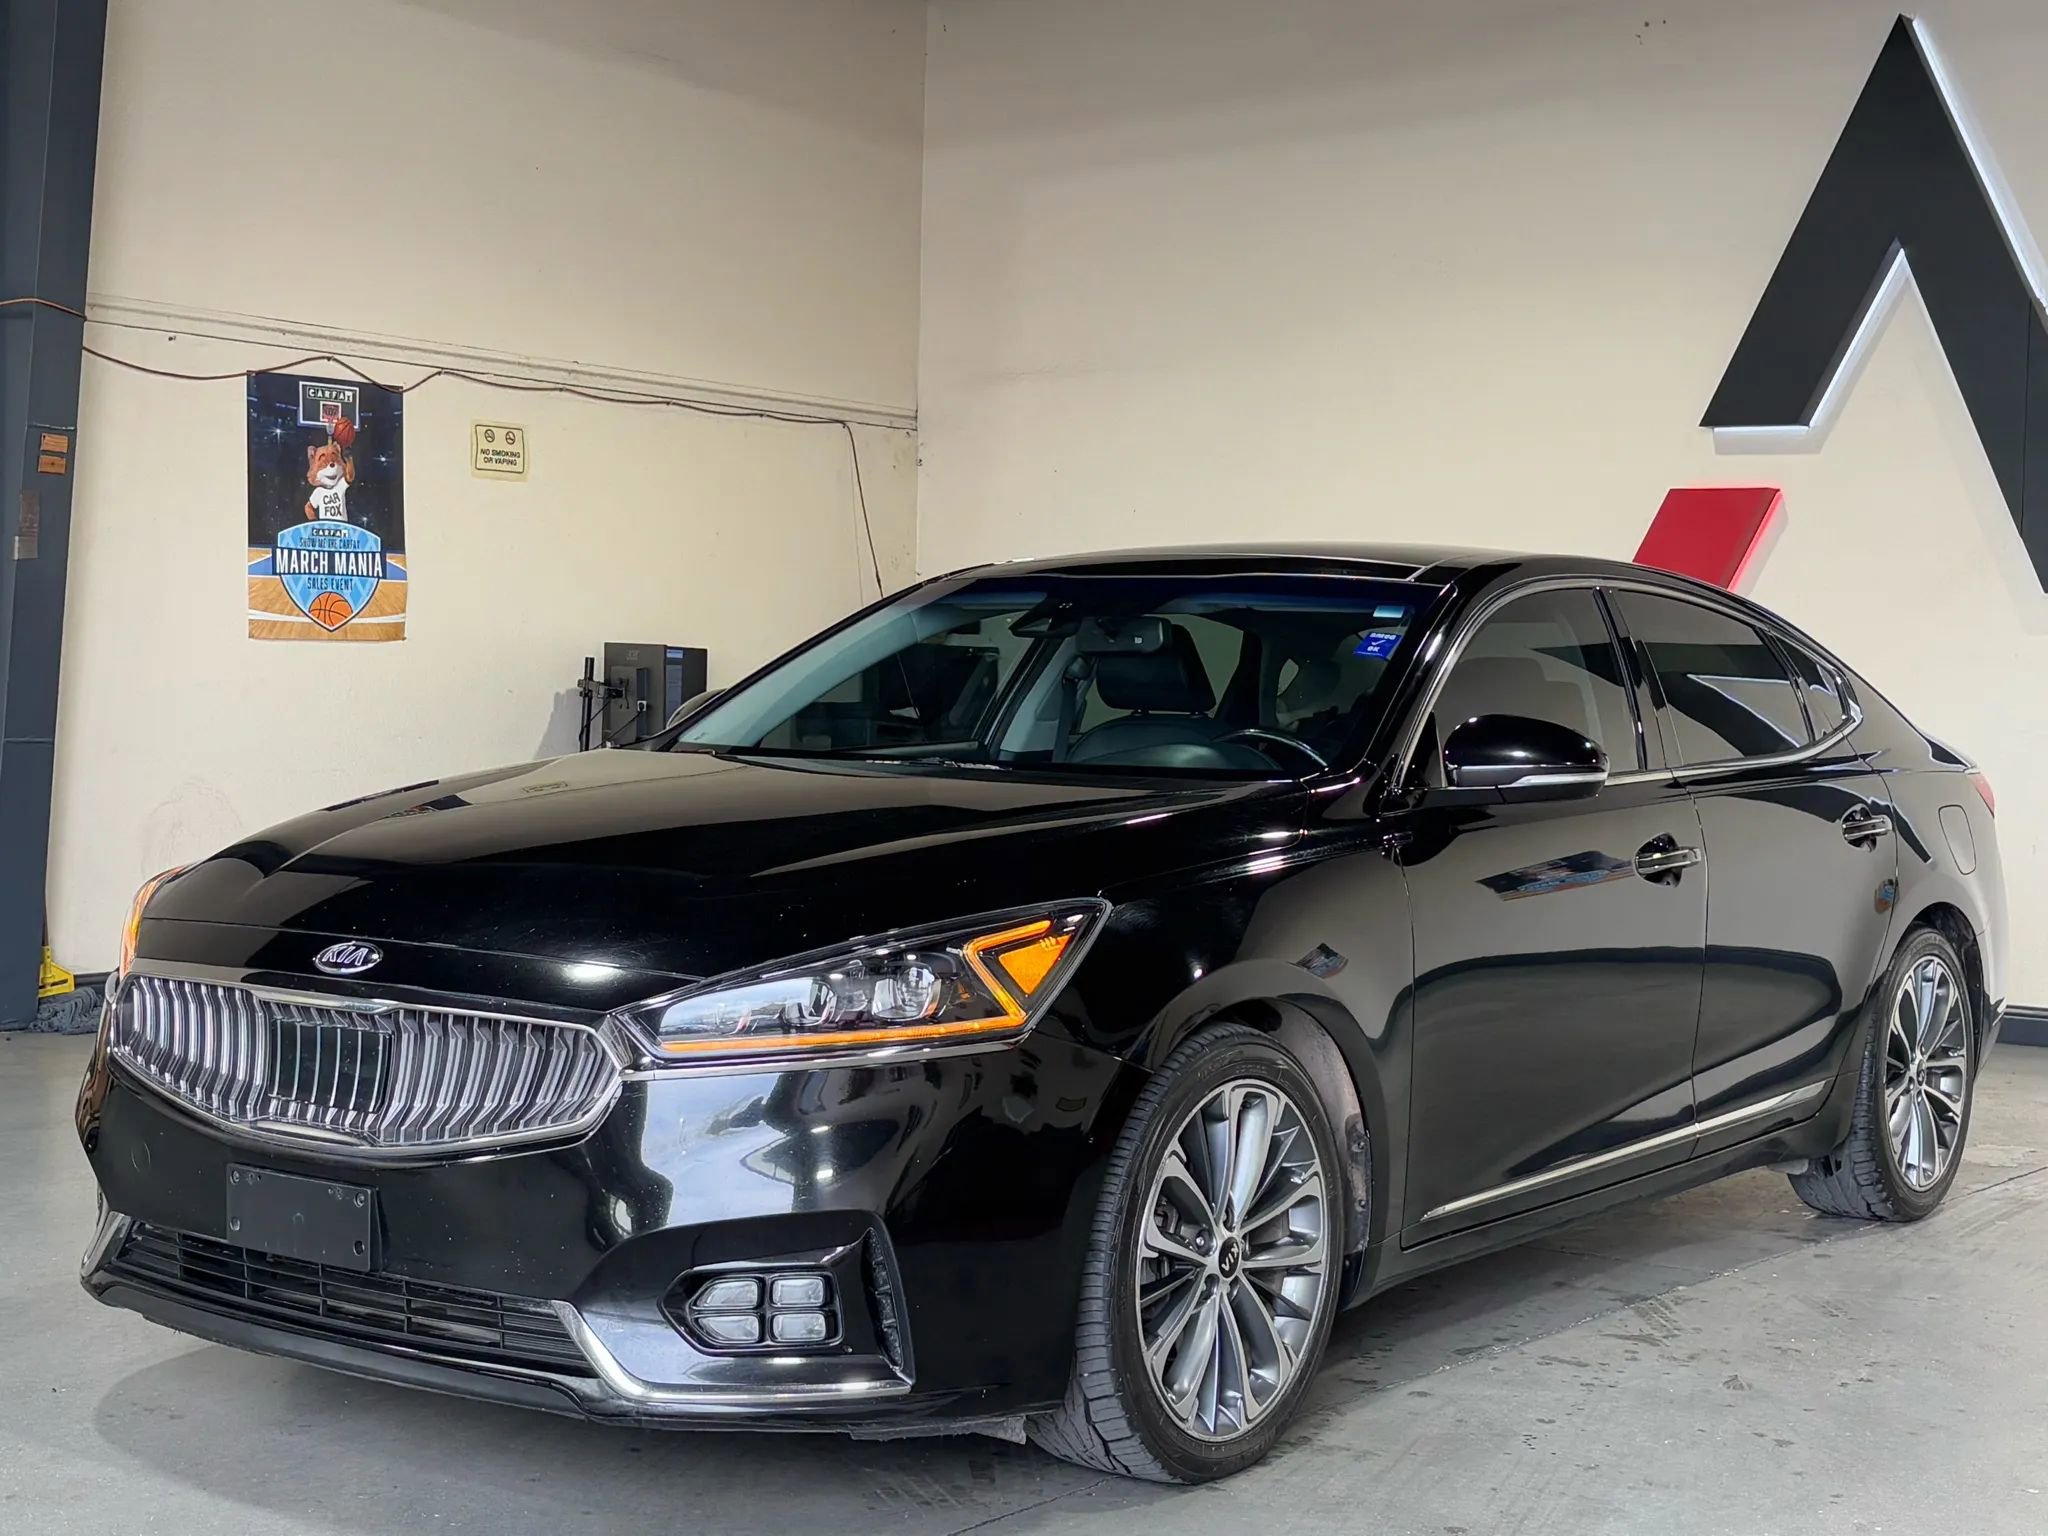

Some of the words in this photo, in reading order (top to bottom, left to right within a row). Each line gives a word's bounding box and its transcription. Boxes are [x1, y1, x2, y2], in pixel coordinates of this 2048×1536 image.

[308, 388, 353, 402] CARFAX
[480, 448, 491, 456] NO
[491, 449, 521, 459] SMOKING
[483, 456, 494, 464] OR
[494, 457, 518, 466] VAPING
[322, 492, 341, 505] CAR
[324, 503, 342, 517] FOX
[312, 529, 349, 537] CARFAX
[275, 547, 329, 574] MARCH
[334, 552, 383, 578] MANIA
[307, 576, 329, 591] SALES
[330, 577, 353, 591] EVENT
[321, 944, 369, 967] KIA
[1220, 1242, 1240, 1272] KIA
